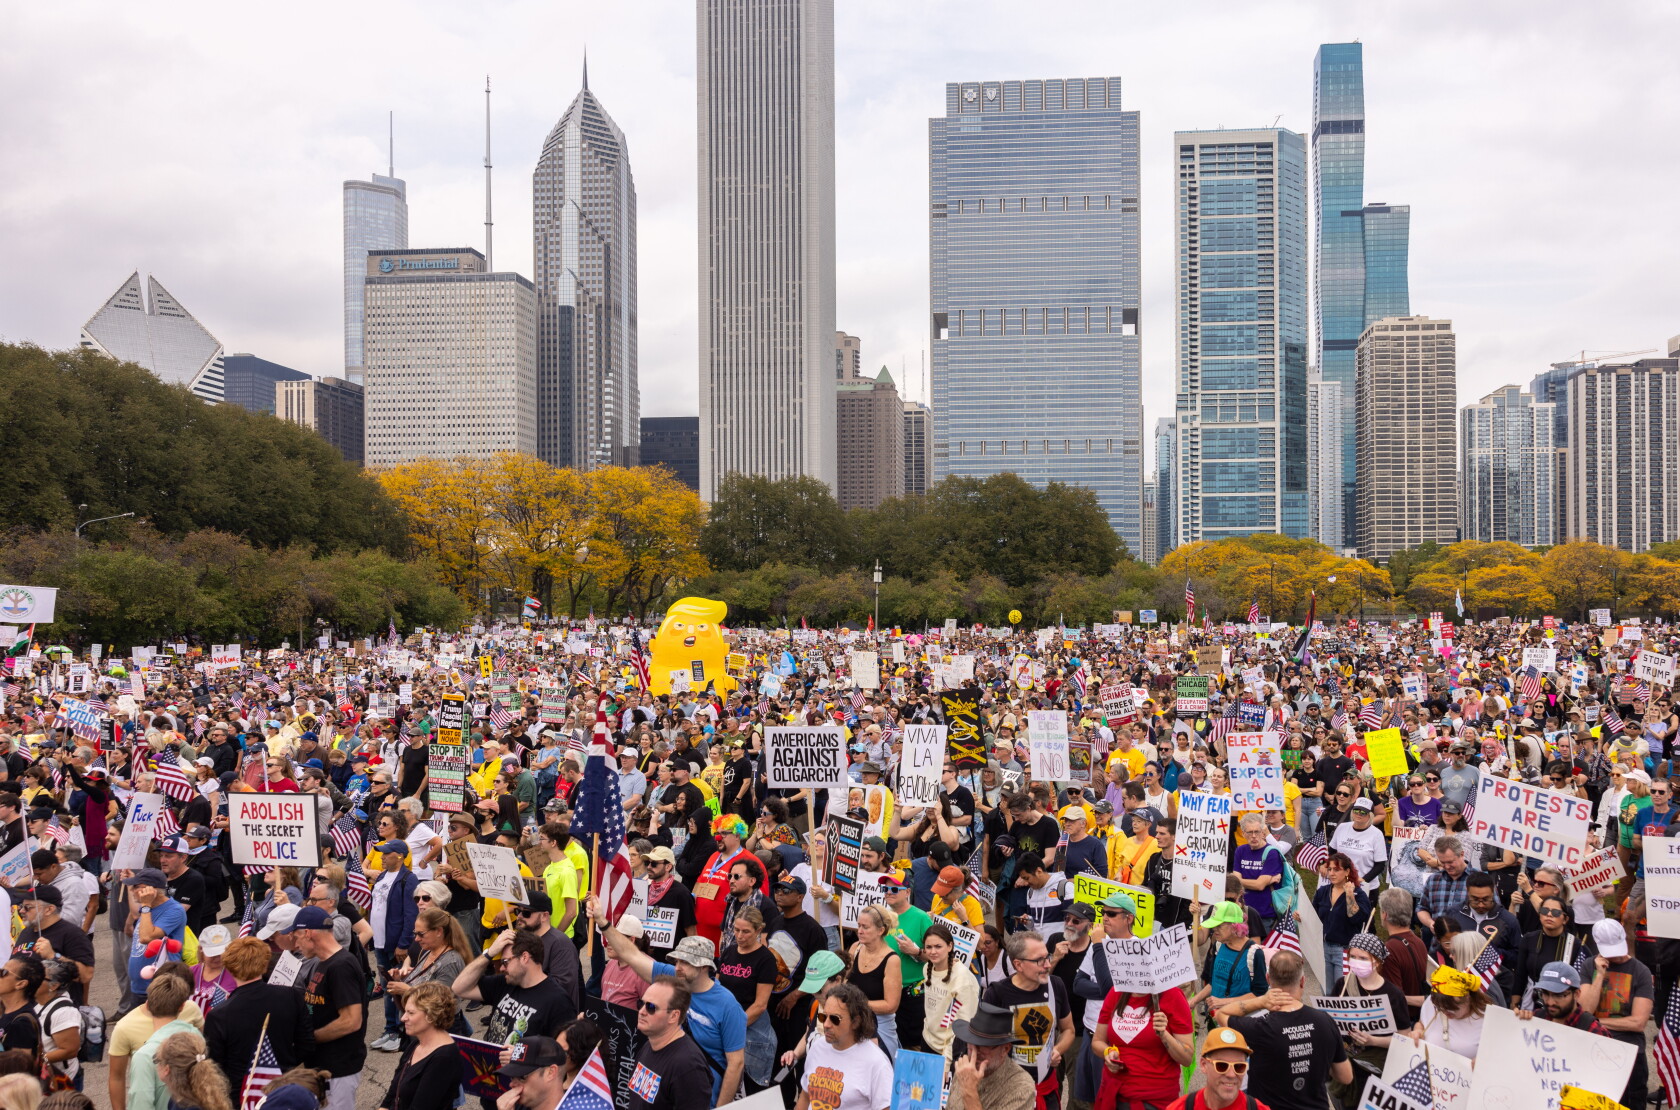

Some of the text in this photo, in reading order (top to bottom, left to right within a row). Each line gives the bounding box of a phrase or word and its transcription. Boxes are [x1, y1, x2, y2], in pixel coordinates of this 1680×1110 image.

[400, 258, 460, 270] Prudential
[1642, 654, 1666, 667] STOP
[1642, 665, 1670, 680] TRUMP
[64, 697, 77, 707] WE
[1101, 689, 1131, 701] CRIMES
[443, 705, 462, 714] Trump
[1109, 701, 1129, 710] FREE
[68, 707, 95, 725] YIELD
[442, 712, 462, 720] Fascist
[1050, 712, 1060, 720] ALL
[440, 720, 461, 728] Regime
[1037, 722, 1058, 730] ENDS
[771, 733, 838, 747] AMERICANS
[908, 728, 937, 744] VIVA
[1227, 735, 1263, 747] ELECT
[430, 745, 464, 757] STOP THE
[773, 748, 839, 767] AGAINST
[914, 748, 933, 767] LA
[1240, 753, 1249, 763] A
[1040, 753, 1064, 778] NO
[1231, 767, 1281, 778] EXPECT
[774, 767, 840, 782] OLIGARCHY
[1251, 779, 1261, 789] A
[1182, 793, 1230, 815] WHY FEAR
[1234, 792, 1283, 808] CIRCUS
[1482, 778, 1589, 821] PROTESTS
[240, 802, 304, 821] ABOLISH
[1178, 814, 1215, 834] ADELITA
[1512, 808, 1551, 832] ARE
[242, 824, 304, 837] THE SECRET
[841, 824, 859, 840] RESIST.
[1395, 827, 1420, 839] TRUMP IS
[444, 841, 470, 856] LOC
[1187, 836, 1227, 856] GRIJALVA
[1475, 820, 1580, 864] PATRIOTIC
[254, 841, 298, 860] POLICE
[838, 843, 859, 859] PERSIST.
[1190, 851, 1206, 862] ???
[836, 861, 856, 878] REPEAT.
[476, 871, 506, 888] STINKS!
[1571, 867, 1618, 892] TRUMP!
[660, 910, 674, 920] OFF
[934, 917, 975, 942] HANDS OFF
[1106, 926, 1185, 955] CHECKMATE
[1154, 963, 1176, 975] UNIDO
[1160, 967, 1190, 983] VENCIDO
[497, 994, 536, 1020] RESIST
[1316, 998, 1382, 1009] HANDS OFF
[1282, 1023, 1315, 1034] JACQUELINE
[1336, 1018, 1389, 1032] HICAGO
[1288, 1031, 1311, 1040] VAUGHN
[1522, 1029, 1556, 1052] We
[1288, 1048, 1313, 1058] STEWART
[1289, 1042, 1312, 1052] MARILYN
[911, 1058, 925, 1075] NO
[809, 1073, 844, 1094] FUCKING
[808, 1085, 841, 1109] STUPID
